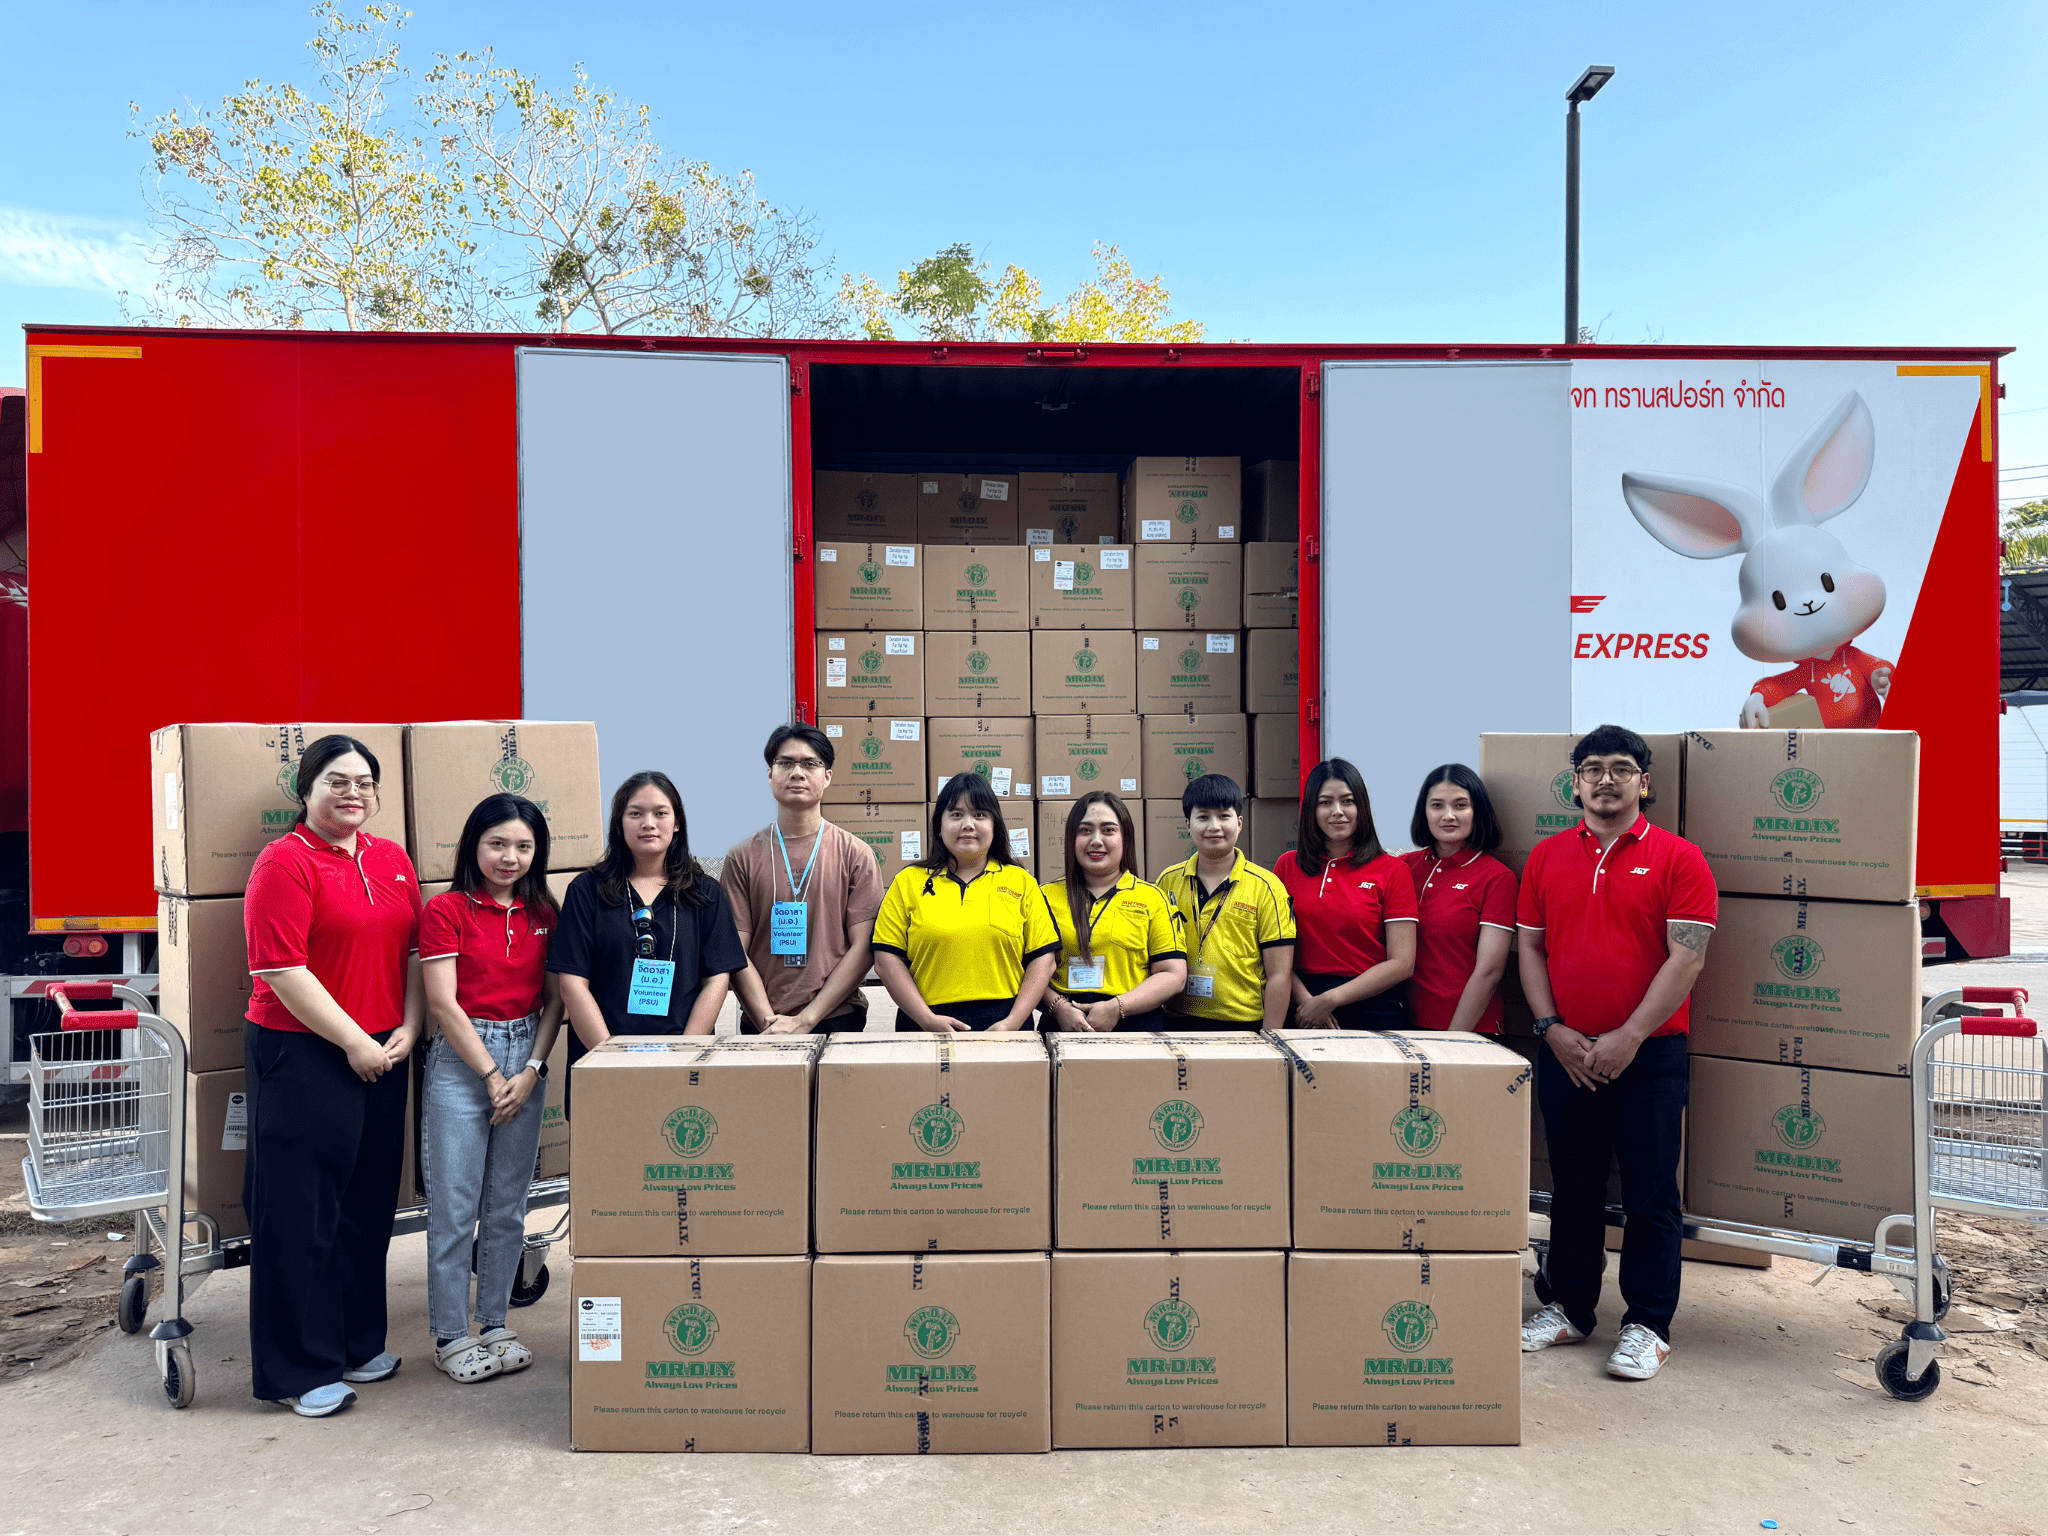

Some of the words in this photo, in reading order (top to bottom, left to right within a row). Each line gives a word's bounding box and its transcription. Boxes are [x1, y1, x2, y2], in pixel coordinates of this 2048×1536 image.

[1605, 379, 1724, 408] ทรานสปอร์ท
[1733, 379, 1785, 408] จำกัด
[1573, 633, 1710, 659] EXPRESS
[1752, 833, 1787, 843] Always
[1788, 834, 1808, 842] Low
[1810, 835, 1841, 843] Prices
[1705, 851, 1728, 859] Please
[1730, 853, 1752, 861] return
[1753, 854, 1767, 862] this
[1805, 858, 1846, 866] warehouse
[1849, 859, 1859, 867] for
[1861, 861, 1890, 869] recycle
[633, 988, 667, 997] Volunteer
[639, 998, 659, 1006] (PSU)
[1752, 998, 1788, 1009] Always
[1789, 1002, 1809, 1010] Low
[1811, 1003, 1842, 1012] Prices
[1754, 1165, 1789, 1177] Always
[1790, 1170, 1810, 1179] Low
[1812, 1173, 1843, 1183] Prices
[890, 1183, 927, 1191] Always
[1371, 1182, 1409, 1191] Always
[840, 1207, 866, 1216] Please
[867, 1208, 892, 1216] return
[892, 1208, 908, 1216] this
[909, 1208, 935, 1216] carton
[936, 1207, 945, 1215] to
[946, 1206, 989, 1215] warehouse
[990, 1206, 1002, 1214] for
[1002, 1206, 1031, 1215] recycle
[1081, 1202, 1108, 1211] Please
[1109, 1203, 1133, 1211] return
[1134, 1203, 1150, 1211] this
[1177, 1203, 1186, 1211] to
[1187, 1203, 1230, 1211] warehouse
[1230, 1203, 1243, 1211] for
[1243, 1203, 1272, 1213] recycle
[1320, 1205, 1347, 1215] Please
[1373, 1207, 1389, 1215] this
[1390, 1209, 1416, 1217] carton
[1426, 1208, 1469, 1217] warehouse
[1470, 1208, 1482, 1216] for
[1483, 1208, 1511, 1219] recycle
[591, 1209, 618, 1217] Please
[618, 1209, 644, 1217] return
[644, 1209, 660, 1217] this
[688, 1208, 697, 1217] to
[698, 1208, 742, 1217] warehouse
[743, 1208, 755, 1216] for
[756, 1208, 785, 1218] recycle
[644, 1381, 682, 1390] Always
[706, 1381, 737, 1389] Prices
[1126, 1378, 1163, 1386] Always
[1363, 1378, 1400, 1386] Always
[946, 1384, 979, 1393] Prices
[593, 1405, 620, 1414] Please
[621, 1406, 646, 1415] return
[646, 1407, 662, 1415] this
[663, 1407, 689, 1415] carton
[690, 1407, 699, 1415] to
[700, 1407, 744, 1416] warehouse
[745, 1407, 757, 1416] for
[757, 1407, 787, 1417] recycle
[1075, 1402, 1102, 1411] Please
[1103, 1403, 1127, 1411] return
[1128, 1403, 1144, 1412] this
[1145, 1404, 1171, 1412] carton
[1172, 1403, 1181, 1411] to
[1181, 1402, 1225, 1411] warehouse
[1226, 1402, 1237, 1410] for
[1238, 1402, 1267, 1411] recycle
[1312, 1402, 1339, 1411] Please
[1340, 1403, 1364, 1411] return
[1365, 1403, 1381, 1411] this
[1381, 1403, 1407, 1411] carton
[1408, 1403, 1418, 1411] to
[1418, 1403, 1461, 1411] warehouse
[1461, 1402, 1474, 1411] for
[1474, 1402, 1502, 1412] recycle
[834, 1410, 861, 1418] Please
[862, 1411, 886, 1419] return
[887, 1411, 903, 1419] this
[931, 1411, 940, 1419] to
[941, 1411, 985, 1419] warehouse
[986, 1410, 998, 1419] for
[999, 1410, 1028, 1420] recycle
